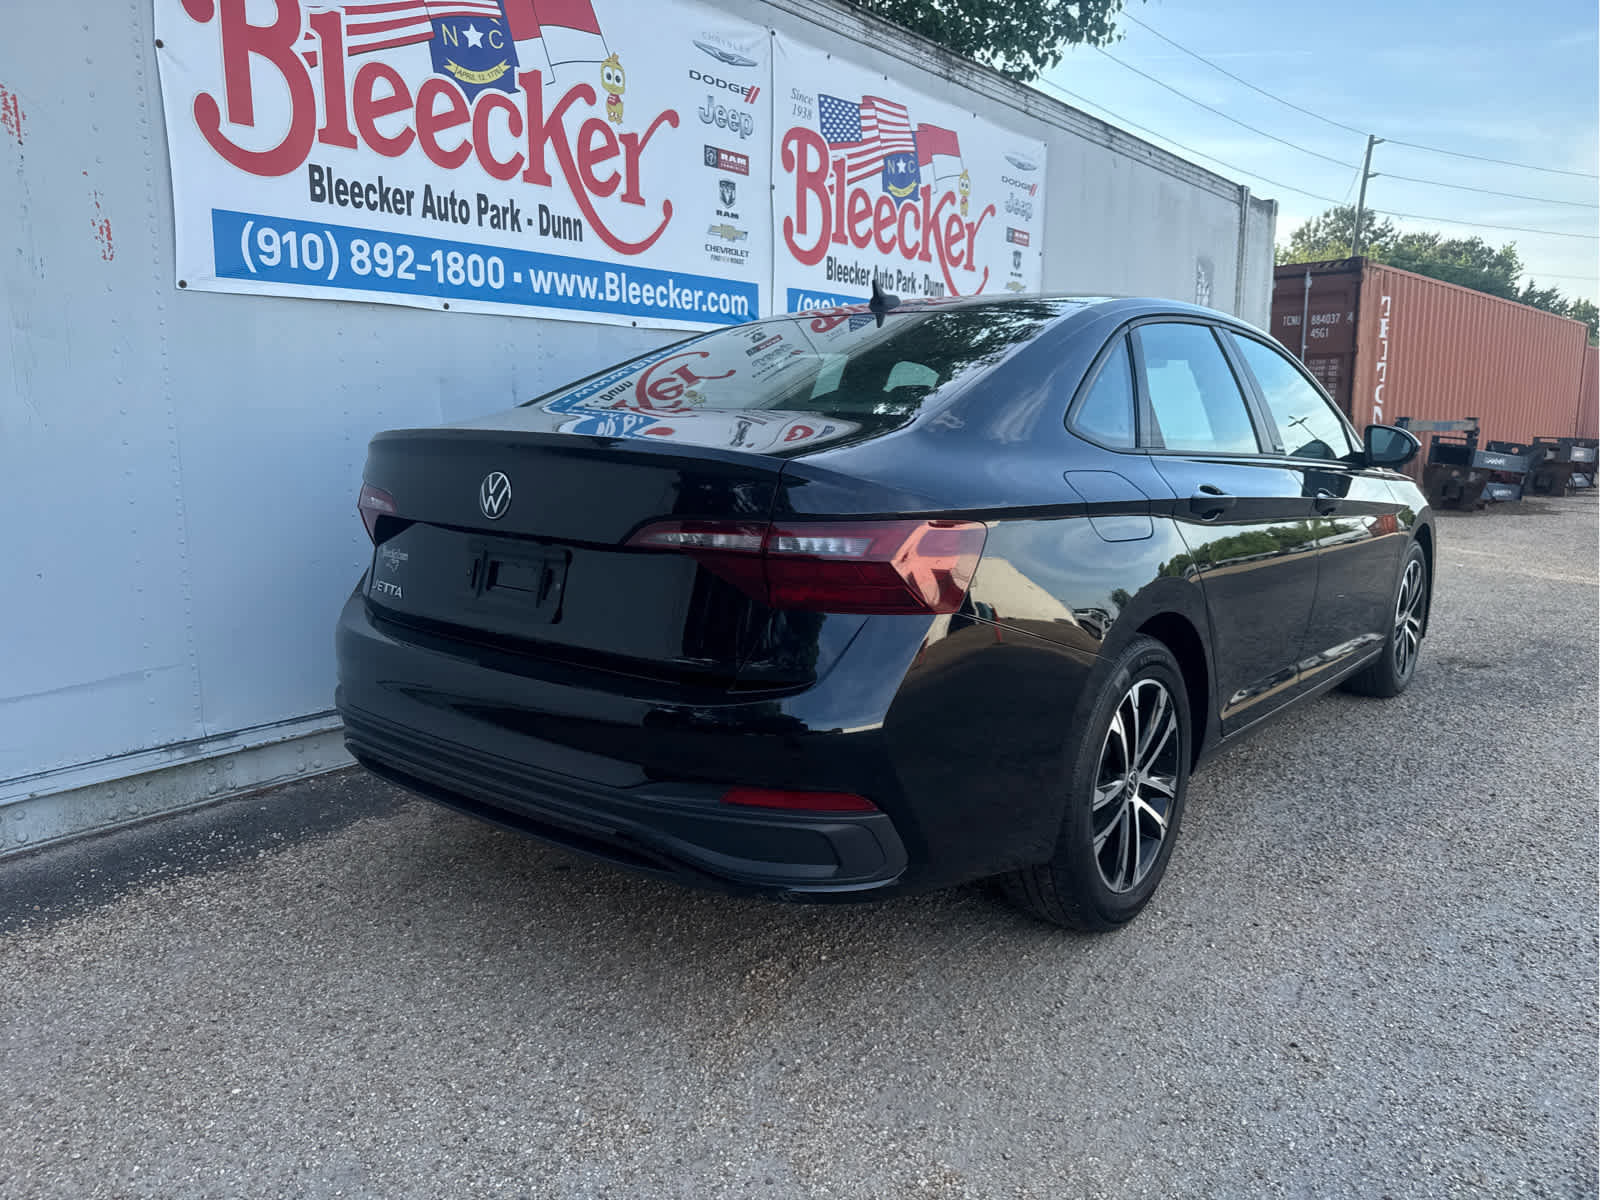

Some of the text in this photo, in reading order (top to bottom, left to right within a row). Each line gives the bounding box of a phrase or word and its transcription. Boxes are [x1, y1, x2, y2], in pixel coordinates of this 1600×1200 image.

[689, 69, 752, 97] DODGE
[181, 0, 680, 256] Bleecker
[698, 94, 754, 140] Jeep
[791, 103, 812, 120] 1938
[308, 163, 584, 243] Bleecker Auto Park Dunn
[716, 208, 739, 220] RAM
[780, 126, 997, 296] Bleecker
[240, 220, 750, 317] (910) 892-1800 www.Bleecker.com
[704, 243, 750, 259] CHEVROLET
[826, 255, 944, 297] Bleecker Auto Park Dunn
[372, 578, 402, 599] JETTA
